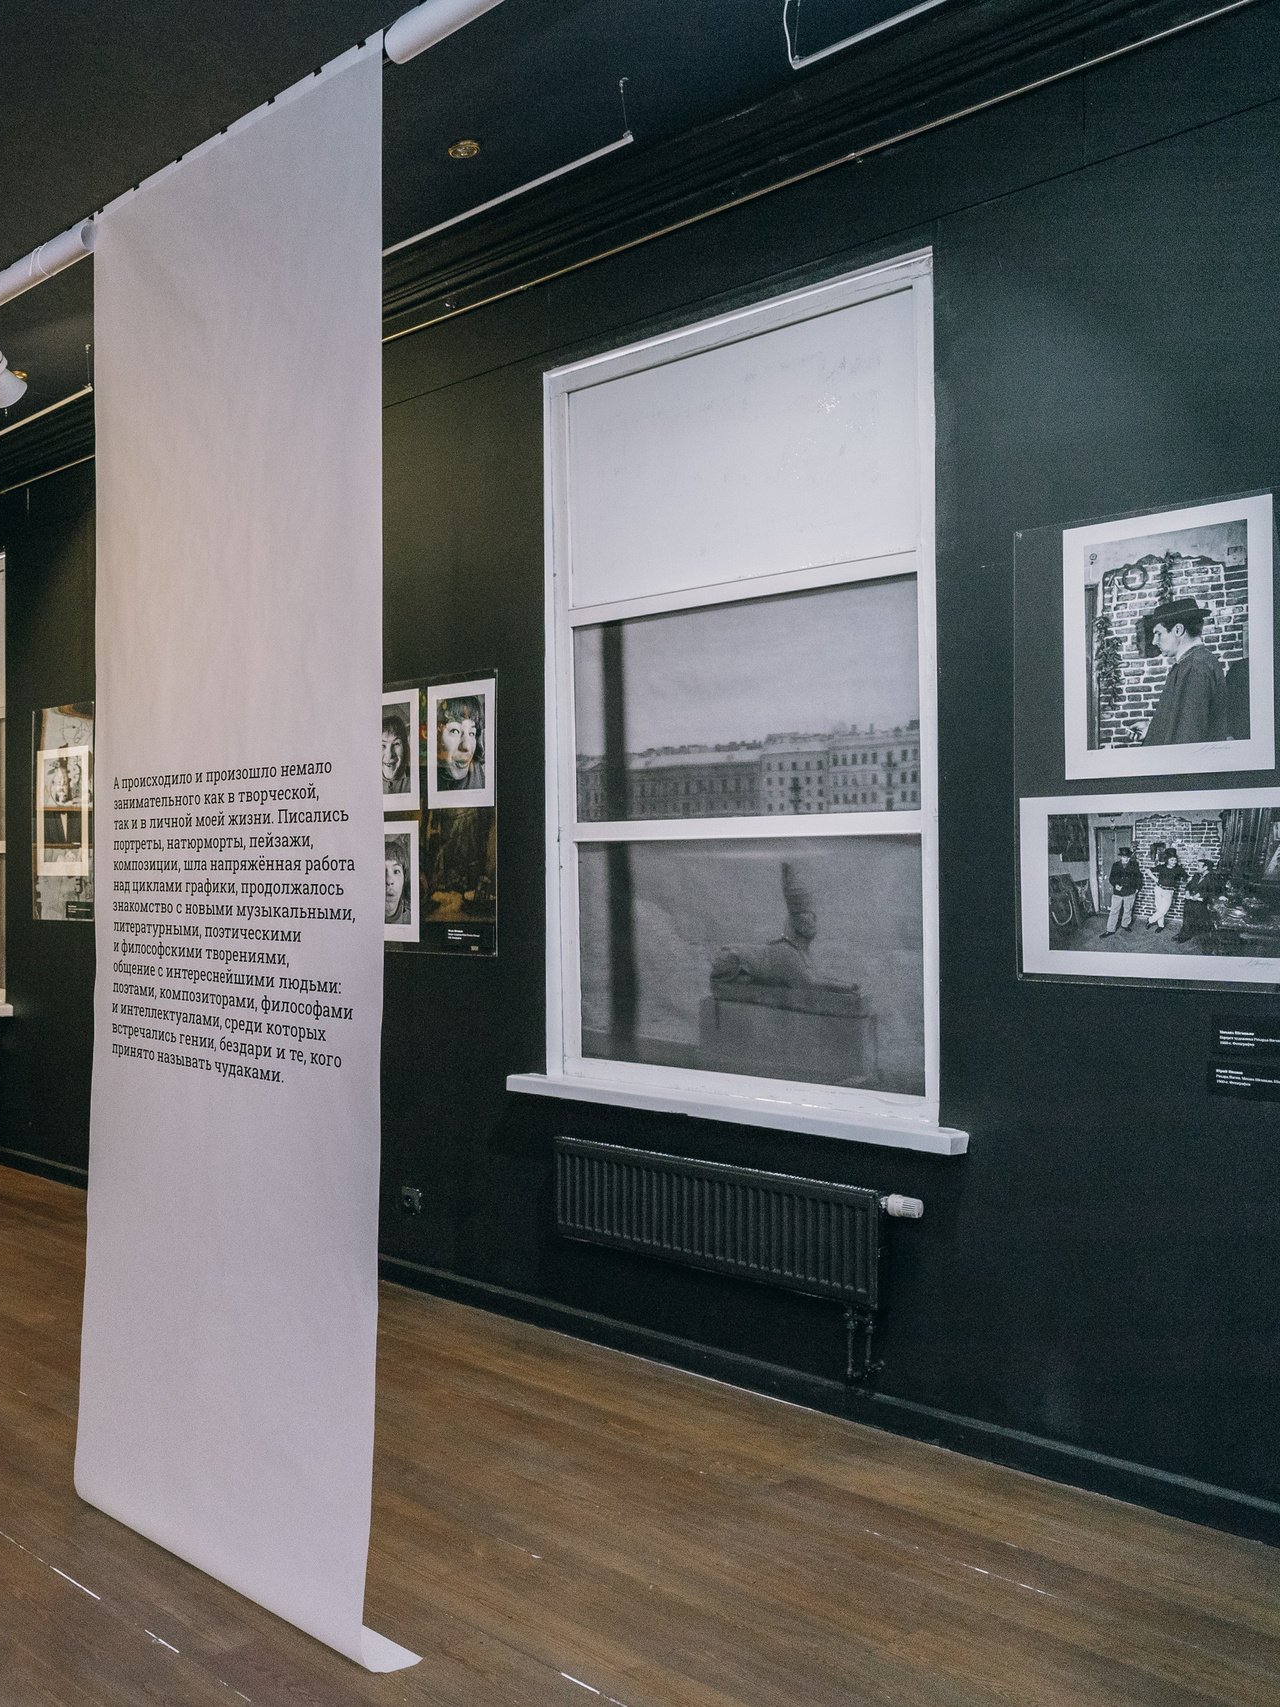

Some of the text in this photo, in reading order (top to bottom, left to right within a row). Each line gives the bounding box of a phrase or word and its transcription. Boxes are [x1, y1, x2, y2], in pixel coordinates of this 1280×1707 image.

[113, 761, 332, 792] А происходило и произошло немало
[114, 783, 320, 810] занимательного как в творческой,
[114, 807, 349, 830] так и в личной моей жизни. Писались
[114, 832, 314, 853] портреты, натюрморты, пейзажи,
[114, 855, 355, 874] композиции, шла напряжённая работа
[114, 878, 344, 897] над циклами графики, продолжалось
[113, 900, 356, 923] знакомство с новыми музыкальными,
[114, 921, 302, 943] литературными, поэтическими
[114, 939, 290, 968] и философскими творениями,
[114, 960, 342, 995] общение с интереснейшими людьми:
[113, 981, 354, 1021] поэтами, композиторами, философами
[112, 1003, 327, 1042] и интеллектуалами, среди которых
[112, 1022, 342, 1068] встречались гении, бездари и те, кого
[112, 1042, 284, 1084] принято называть чудаками.
